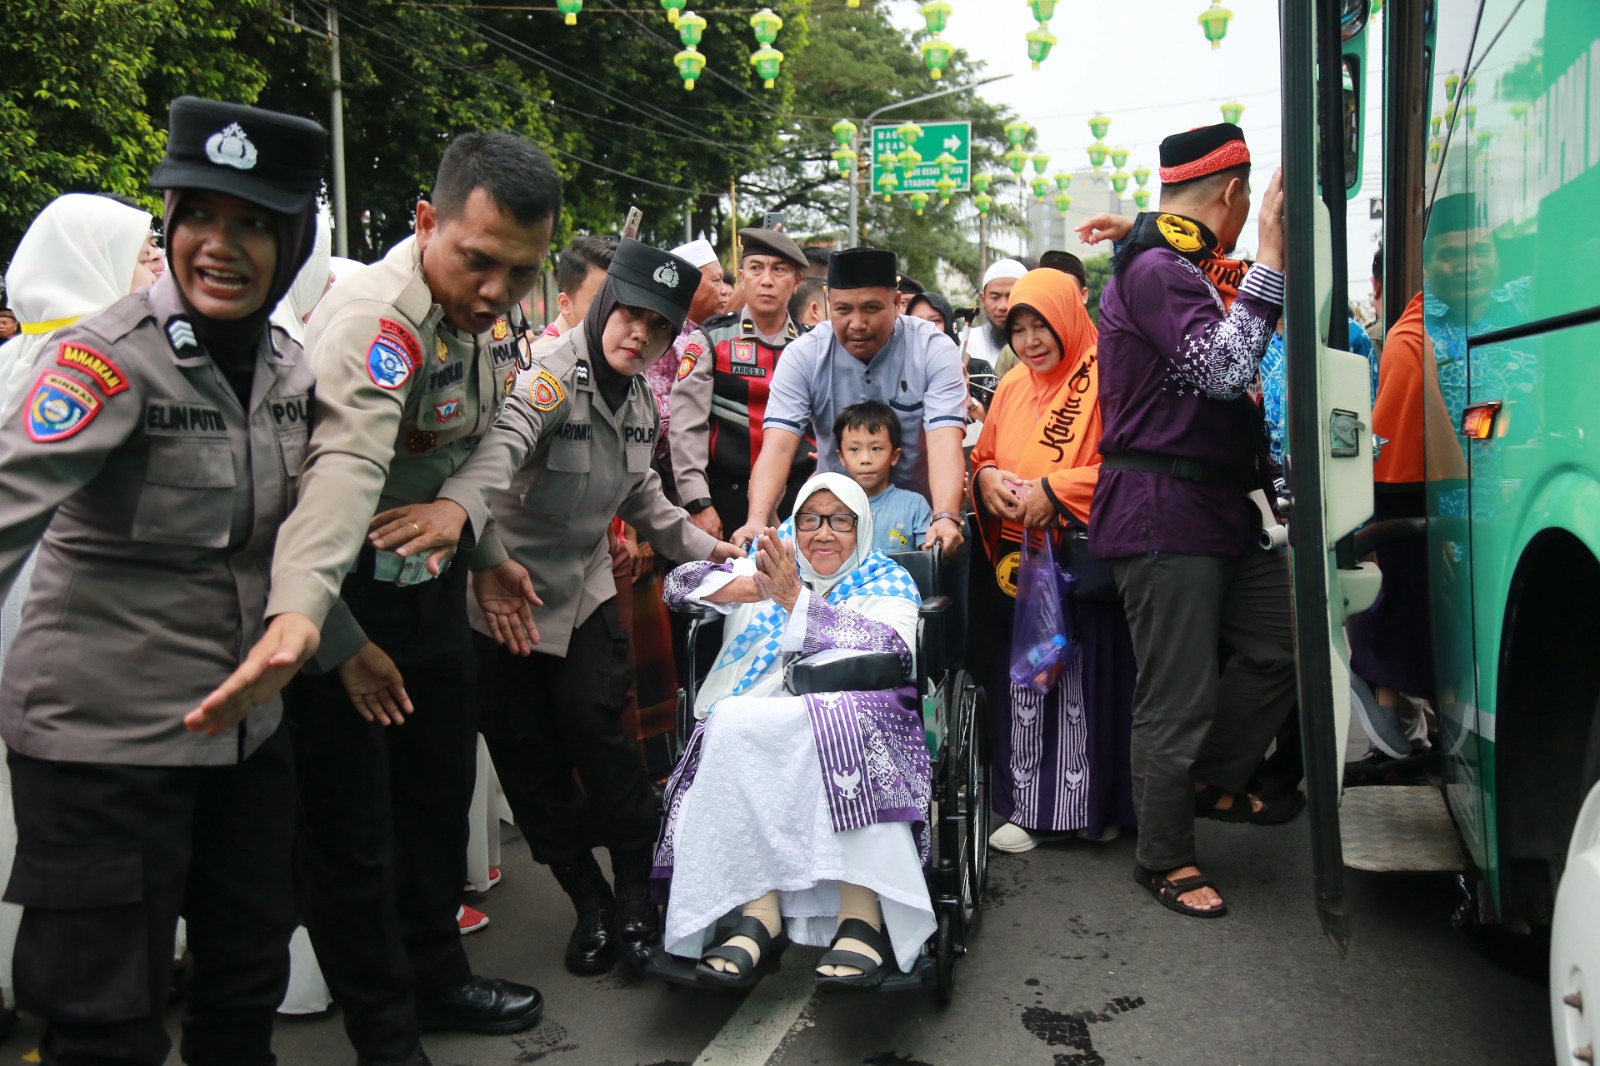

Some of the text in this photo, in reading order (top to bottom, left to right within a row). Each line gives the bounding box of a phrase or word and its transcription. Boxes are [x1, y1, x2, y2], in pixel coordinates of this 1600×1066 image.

[63, 346, 121, 388] BAHARKAM
[272, 399, 309, 425] POL
[624, 426, 655, 444] POLR
